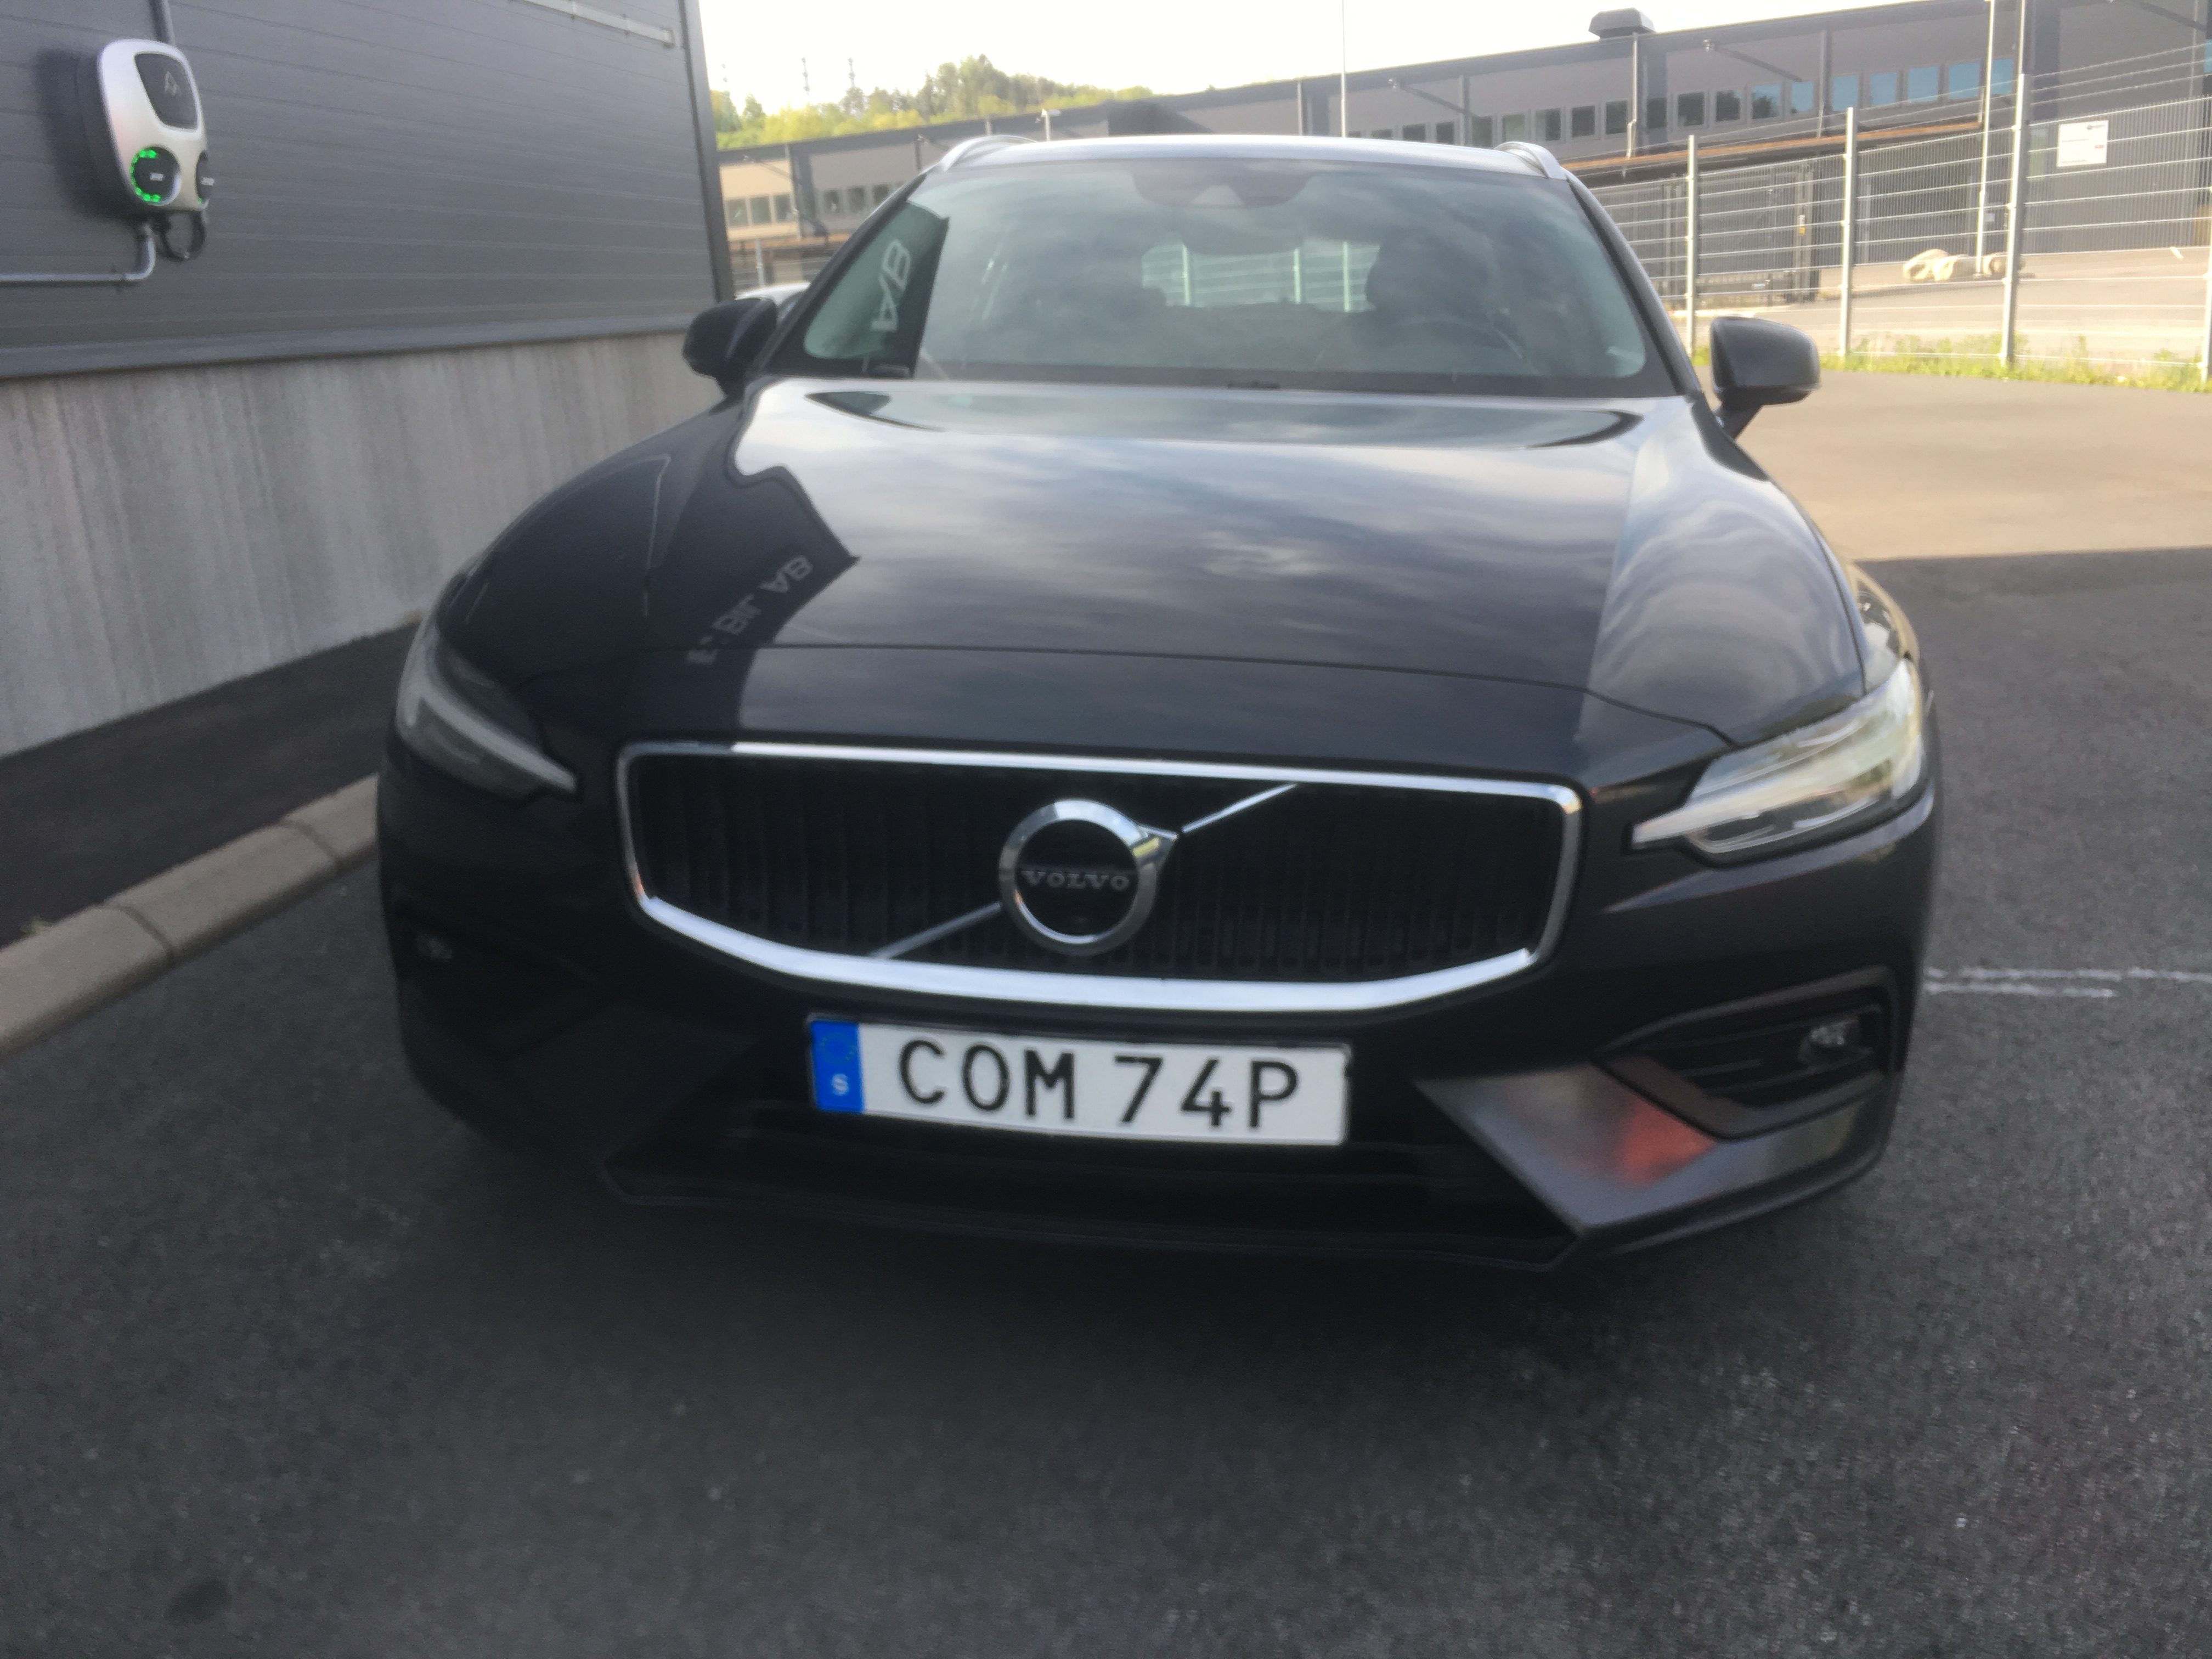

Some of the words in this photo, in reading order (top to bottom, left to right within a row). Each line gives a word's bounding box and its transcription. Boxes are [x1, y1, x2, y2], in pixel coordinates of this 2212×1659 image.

[1021, 870, 1130, 891] VOLVO
[831, 1073, 849, 1096] S
[898, 1039, 1075, 1120] COM
[1114, 1055, 1299, 1130] 74P
